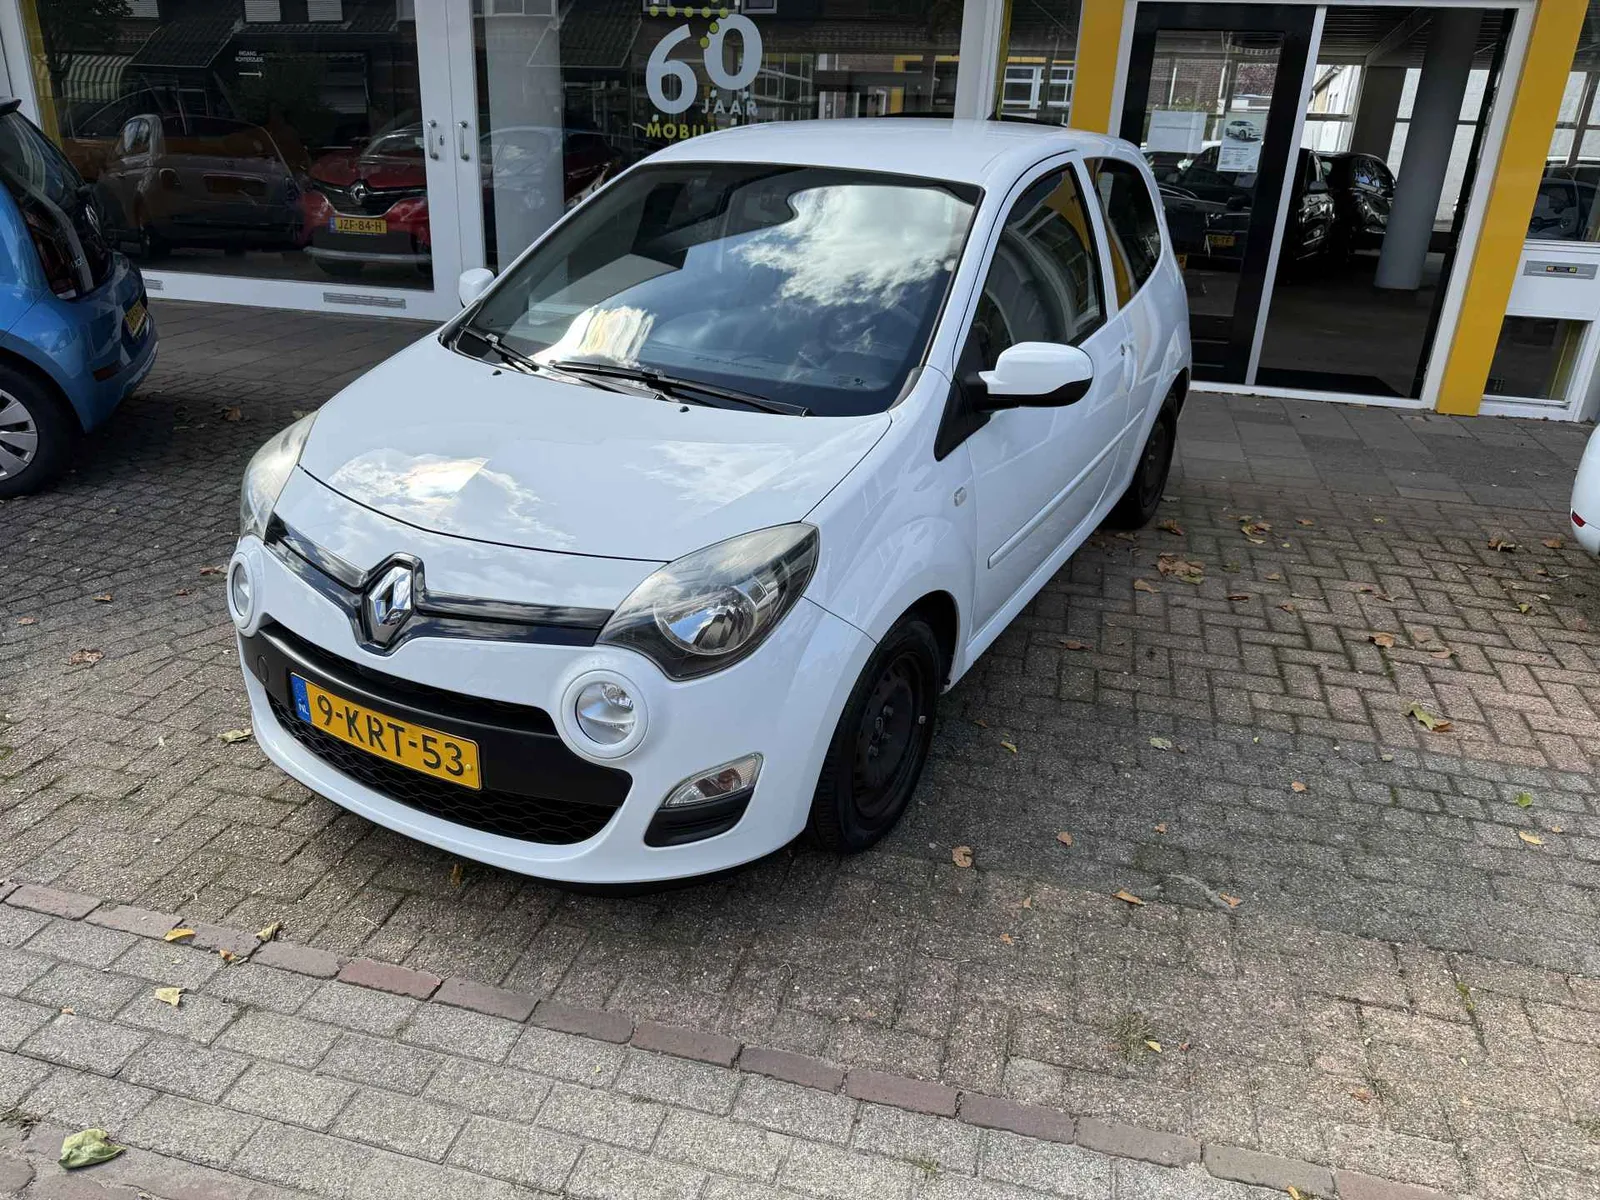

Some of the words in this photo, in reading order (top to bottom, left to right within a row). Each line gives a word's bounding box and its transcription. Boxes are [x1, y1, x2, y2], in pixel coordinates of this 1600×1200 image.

[646, 14, 762, 114] 60
[701, 99, 758, 116] JAAR
[338, 219, 381, 232] JZF-84-H
[317, 694, 464, 776] 9-KRT-53
